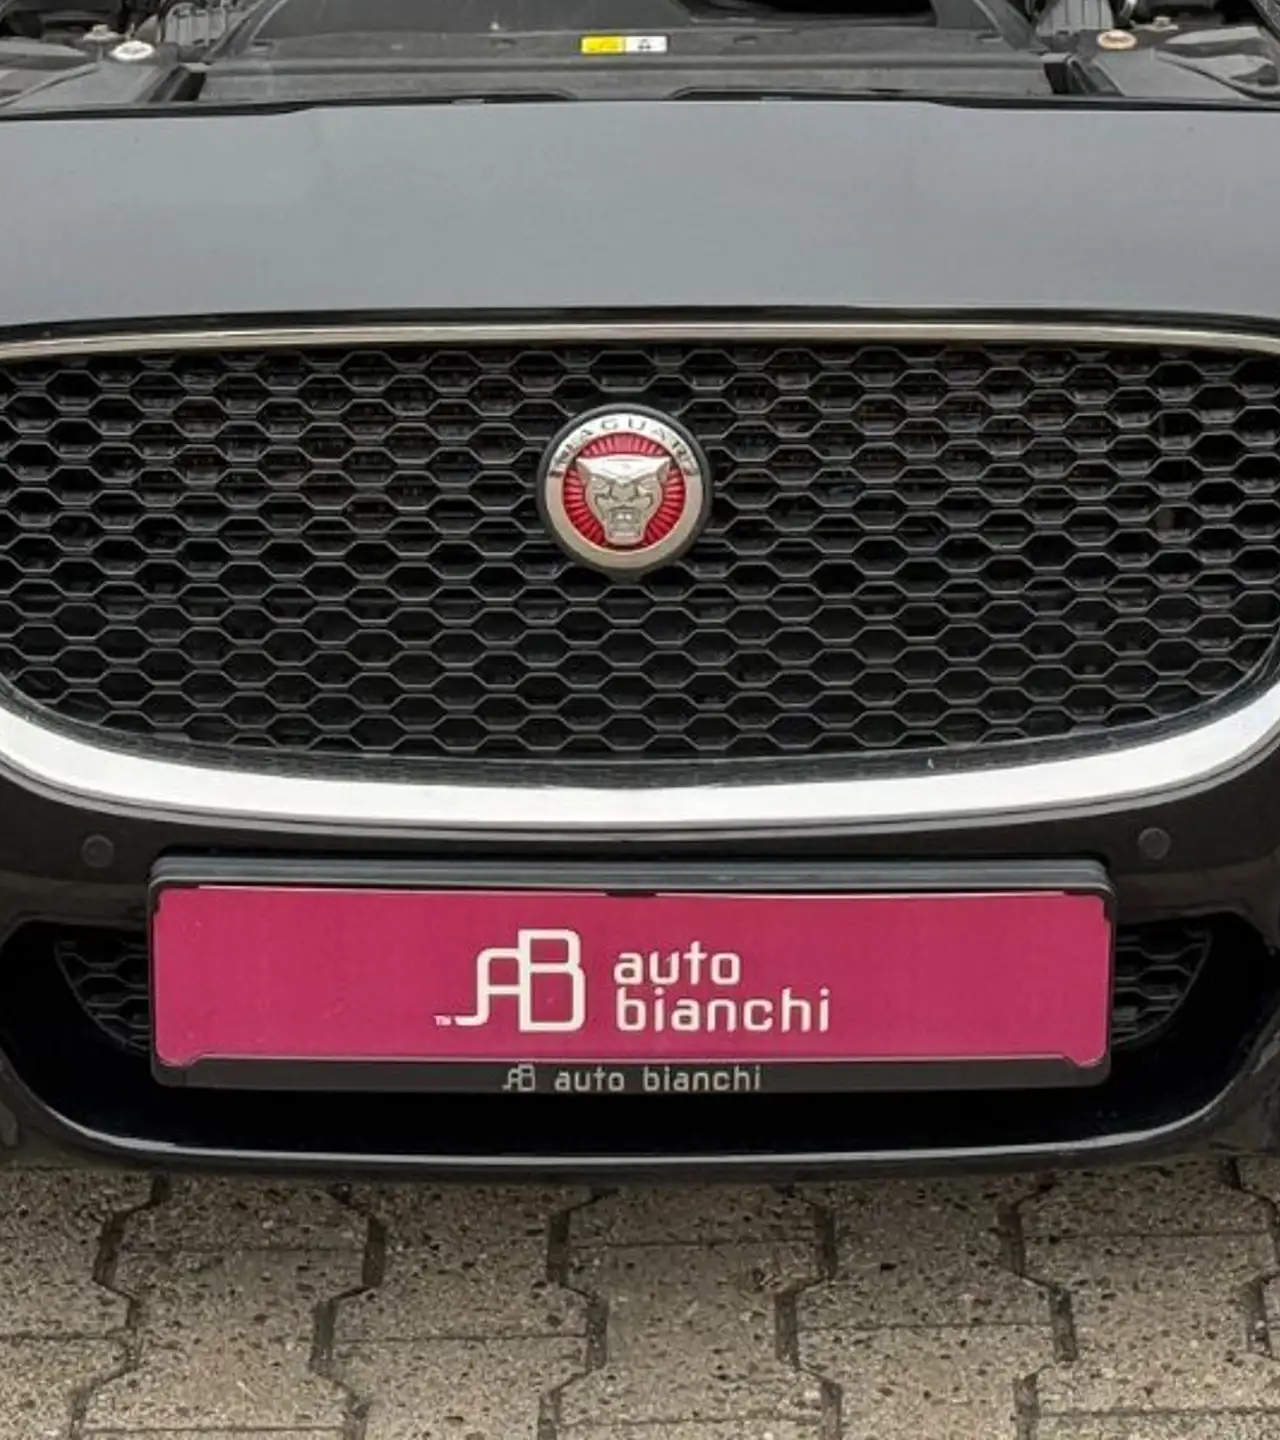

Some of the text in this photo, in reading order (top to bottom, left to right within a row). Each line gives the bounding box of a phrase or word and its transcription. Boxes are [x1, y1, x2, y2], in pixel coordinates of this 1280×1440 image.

[554, 415, 694, 466] JAGUAR
[613, 940, 741, 986] auto
[616, 986, 831, 1034] bianchi
[554, 1065, 625, 1092] auto
[643, 1063, 761, 1092] bianchi
